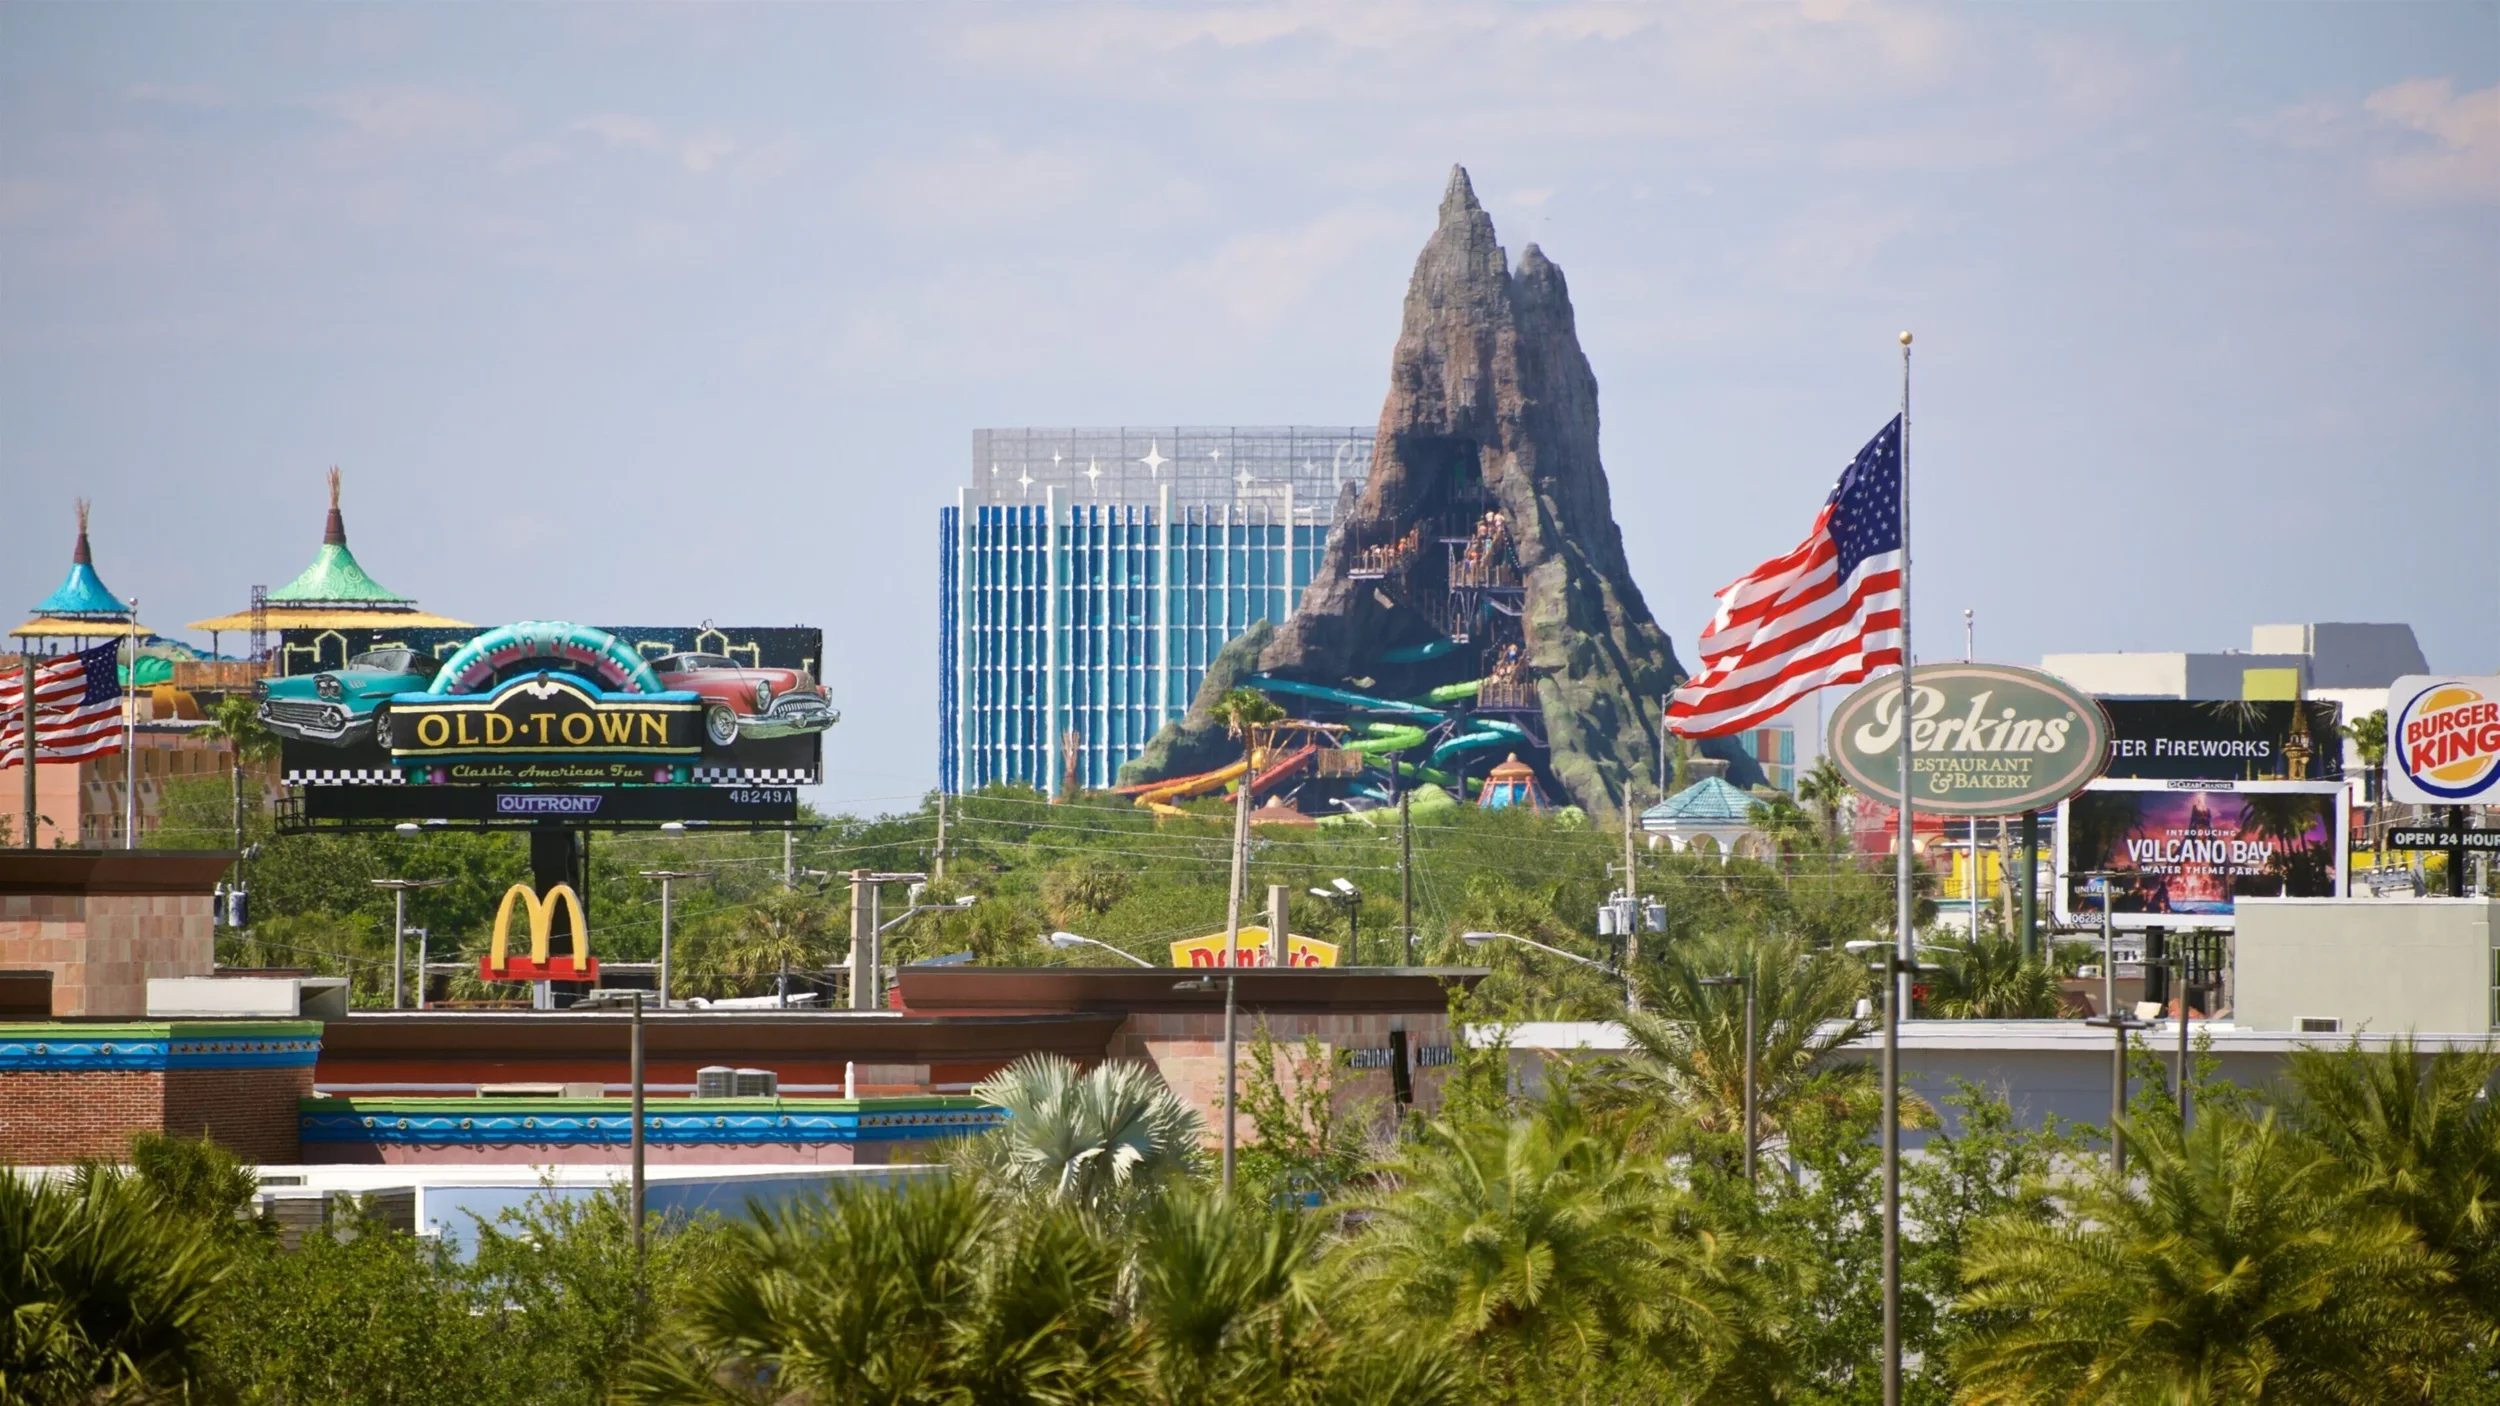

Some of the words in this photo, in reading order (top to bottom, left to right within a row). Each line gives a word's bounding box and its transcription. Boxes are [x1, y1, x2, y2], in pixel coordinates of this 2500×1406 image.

[1854, 685, 2070, 754] Perkins
[2407, 702, 2499, 744] BURGER
[2155, 738, 2270, 757] FIREWORKS
[2411, 723, 2500, 775] KING
[451, 764, 513, 777] Classic
[518, 764, 605, 778] American
[609, 764, 644, 777] Fun
[729, 789, 793, 803] 48249A
[501, 797, 596, 811] OUTFRONT
[2165, 829, 2237, 837] INTRODUCING
[2395, 833, 2436, 845] OPEN
[2439, 833, 2458, 846] 24
[2126, 838, 2227, 864] VOLCANO
[2230, 839, 2274, 865] BAY
[2141, 865, 2181, 875] WATER
[2185, 865, 2225, 876] THEME
[2229, 866, 2261, 876] PARK
[2074, 885, 2126, 895] UNIVESAL
[2072, 913, 2106, 924] 06288
